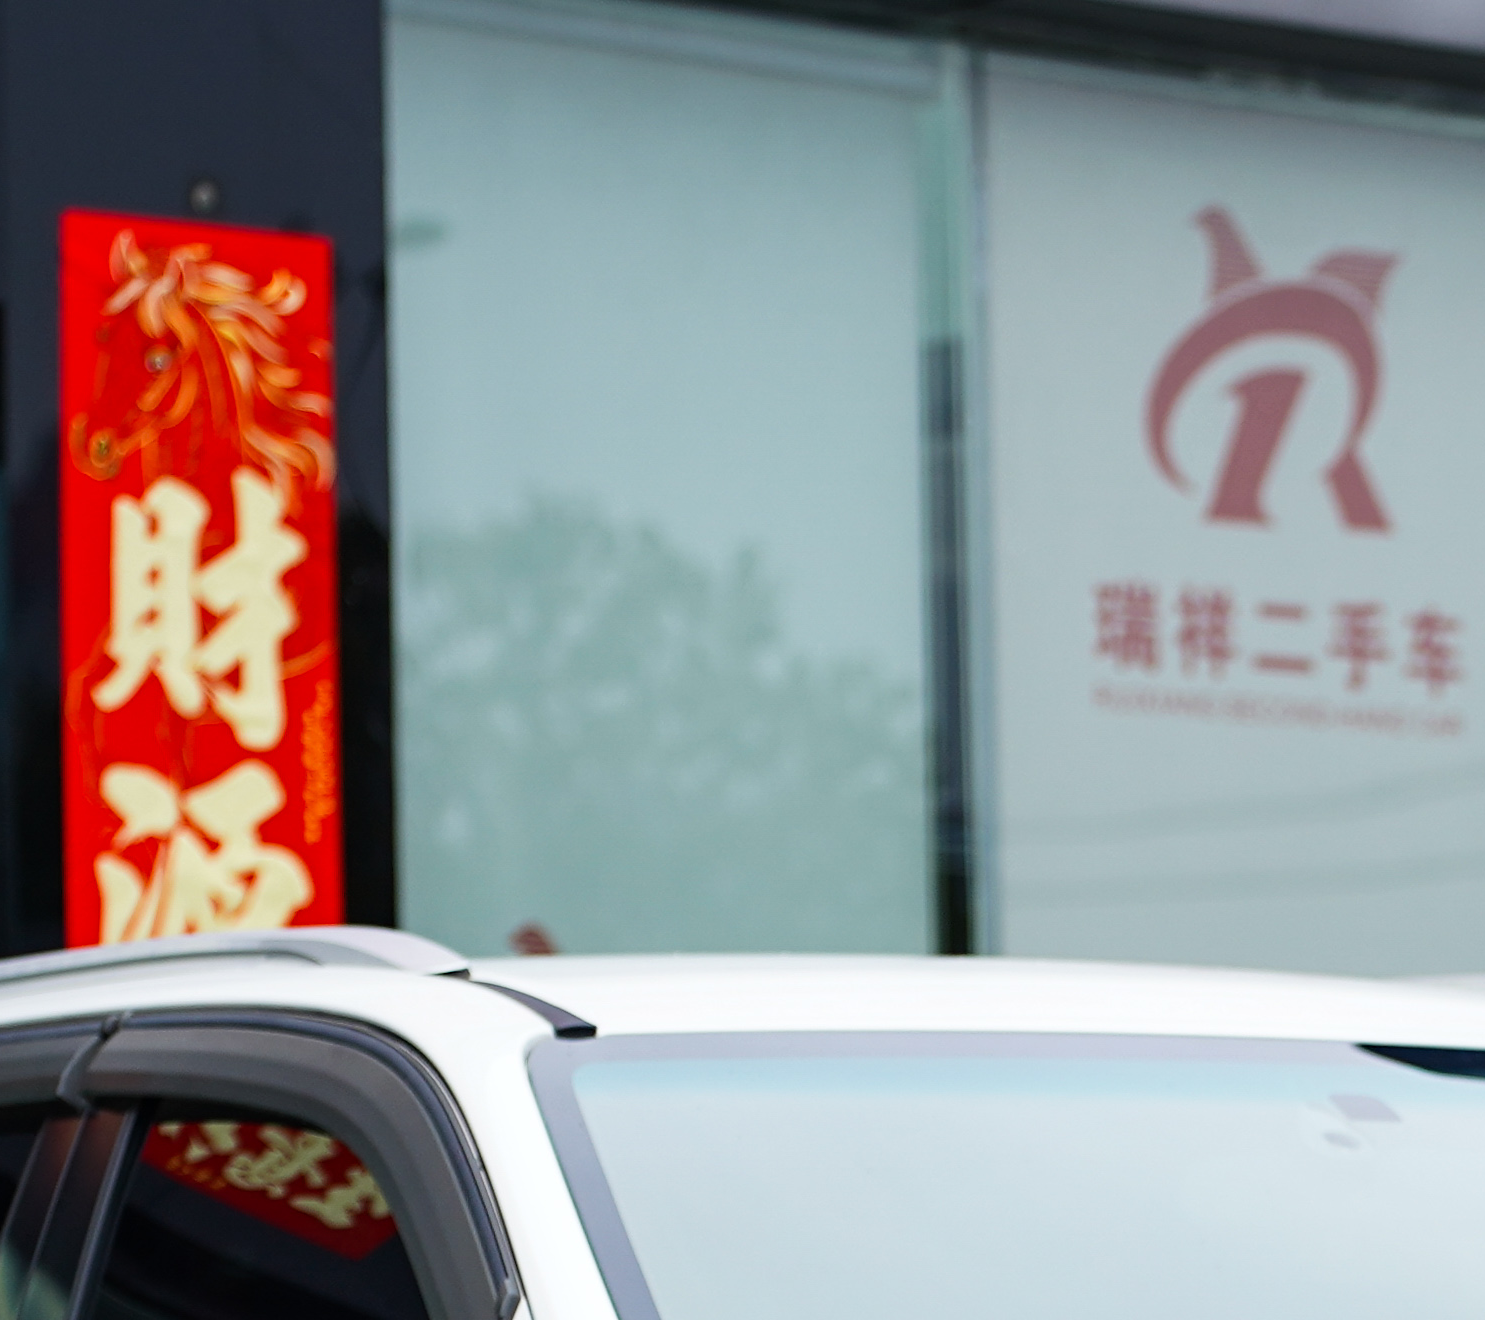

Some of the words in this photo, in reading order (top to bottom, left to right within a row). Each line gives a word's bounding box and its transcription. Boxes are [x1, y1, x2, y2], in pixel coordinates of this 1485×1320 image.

[1093, 582, 1464, 696] 瑞祥二手车
